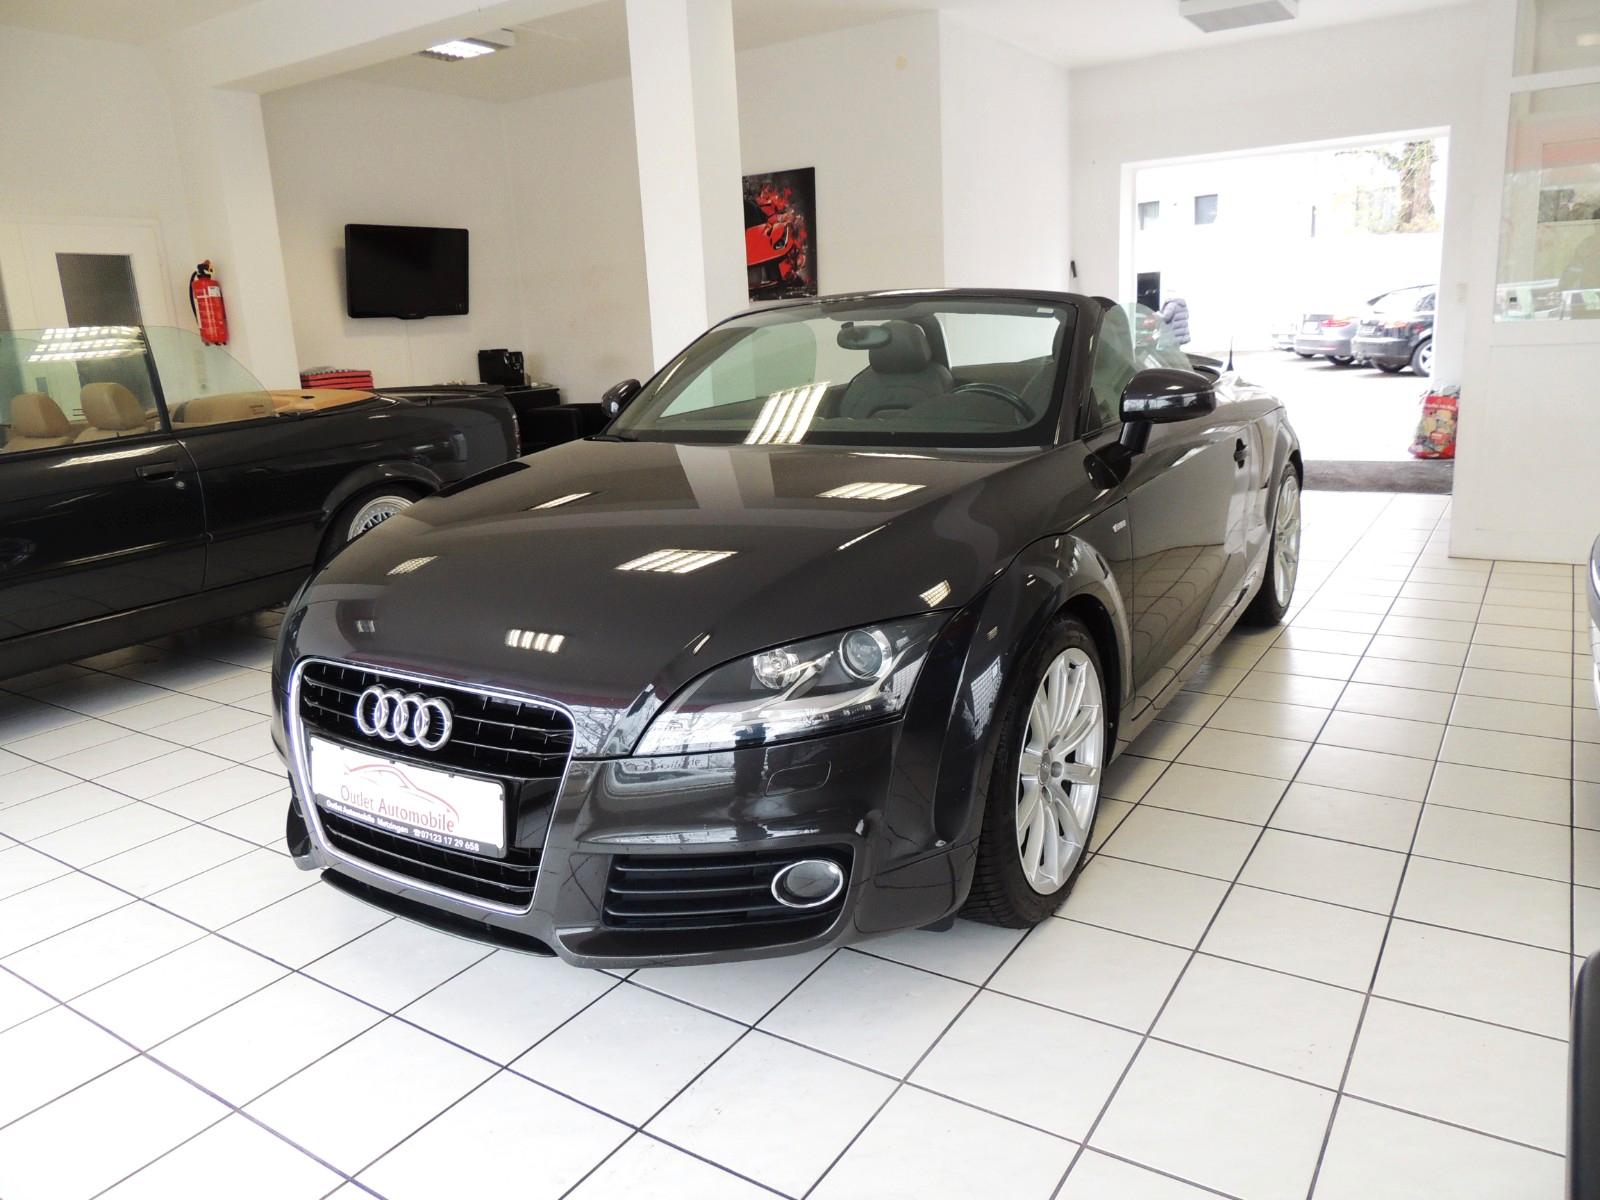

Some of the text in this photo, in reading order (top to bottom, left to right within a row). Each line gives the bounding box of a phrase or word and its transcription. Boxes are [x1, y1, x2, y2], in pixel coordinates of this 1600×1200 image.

[340, 784, 455, 833] Outlet Automobile
[443, 836, 453, 845] 17
[454, 838, 464, 848] 29
[464, 841, 480, 852] 658
